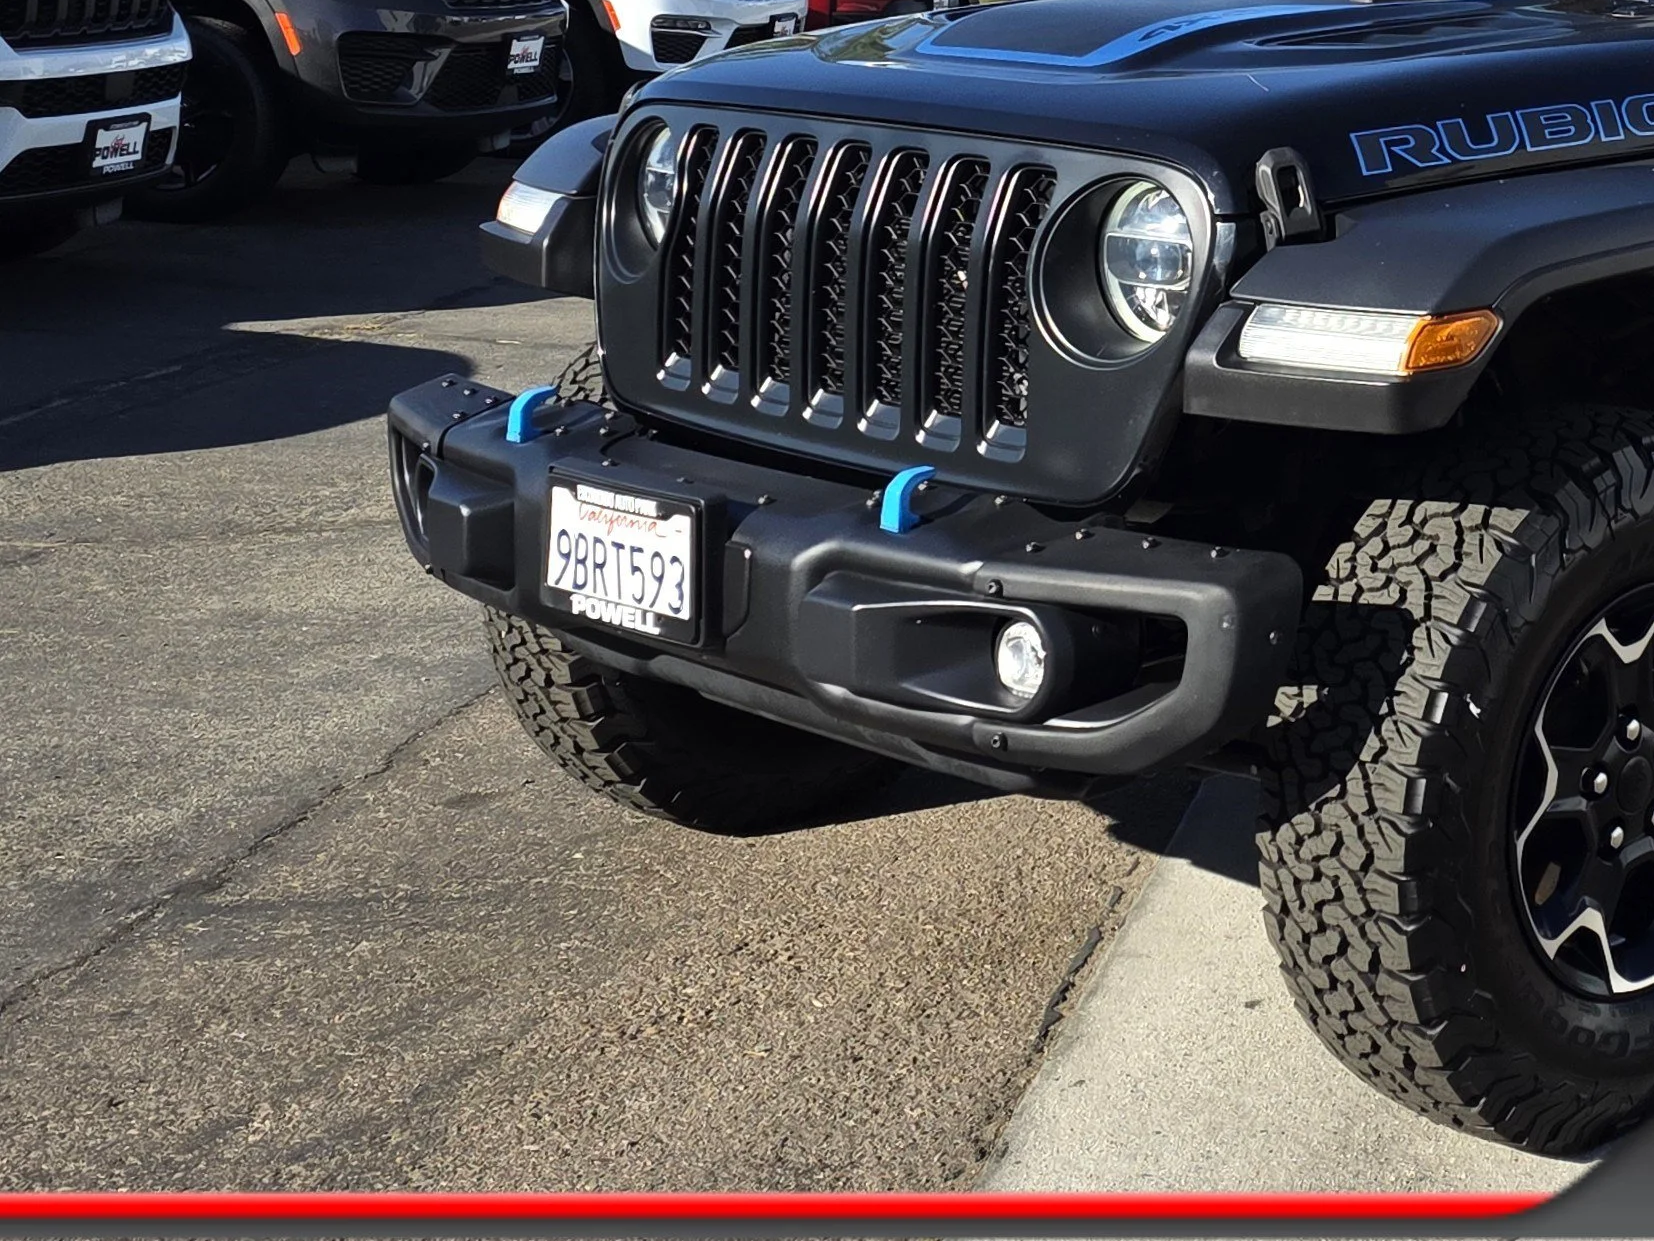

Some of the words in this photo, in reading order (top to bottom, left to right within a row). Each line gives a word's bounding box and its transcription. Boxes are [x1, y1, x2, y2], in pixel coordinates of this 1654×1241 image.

[95, 141, 139, 160] POWELL
[578, 503, 667, 538] California
[554, 528, 685, 615] 9BRT593
[569, 594, 661, 636] POWELL
